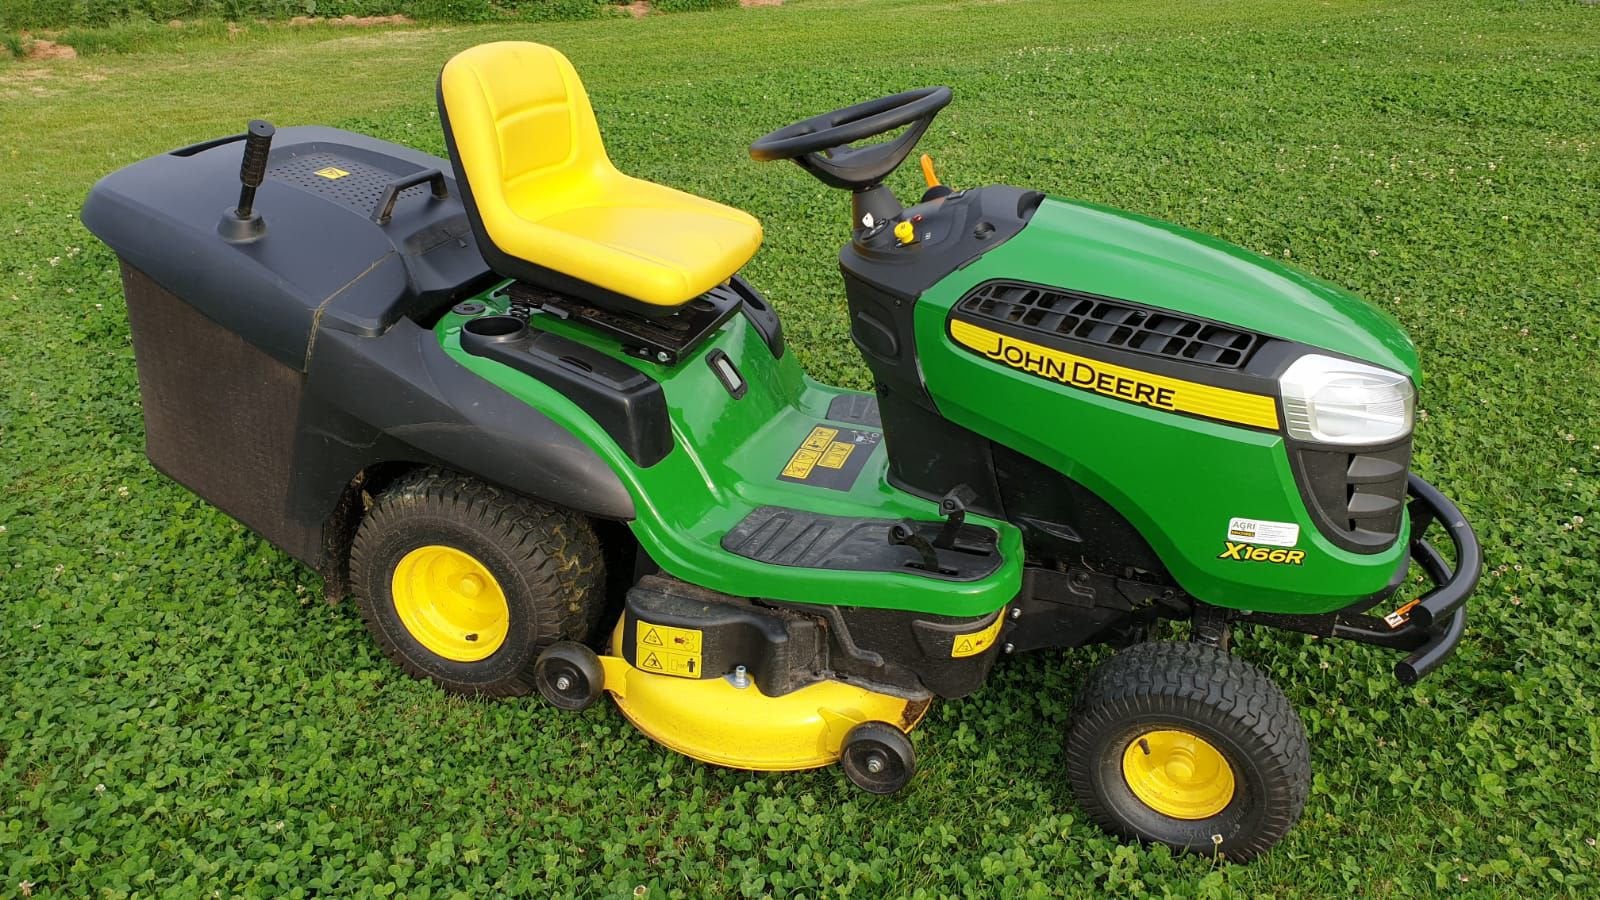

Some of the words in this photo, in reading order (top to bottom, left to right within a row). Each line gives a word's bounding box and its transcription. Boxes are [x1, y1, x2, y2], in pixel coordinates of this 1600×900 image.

[987, 337, 1066, 379] JOHN
[1073, 362, 1175, 407] DEERE
[1232, 521, 1256, 530] AGRI
[1218, 541, 1305, 565] X166R
